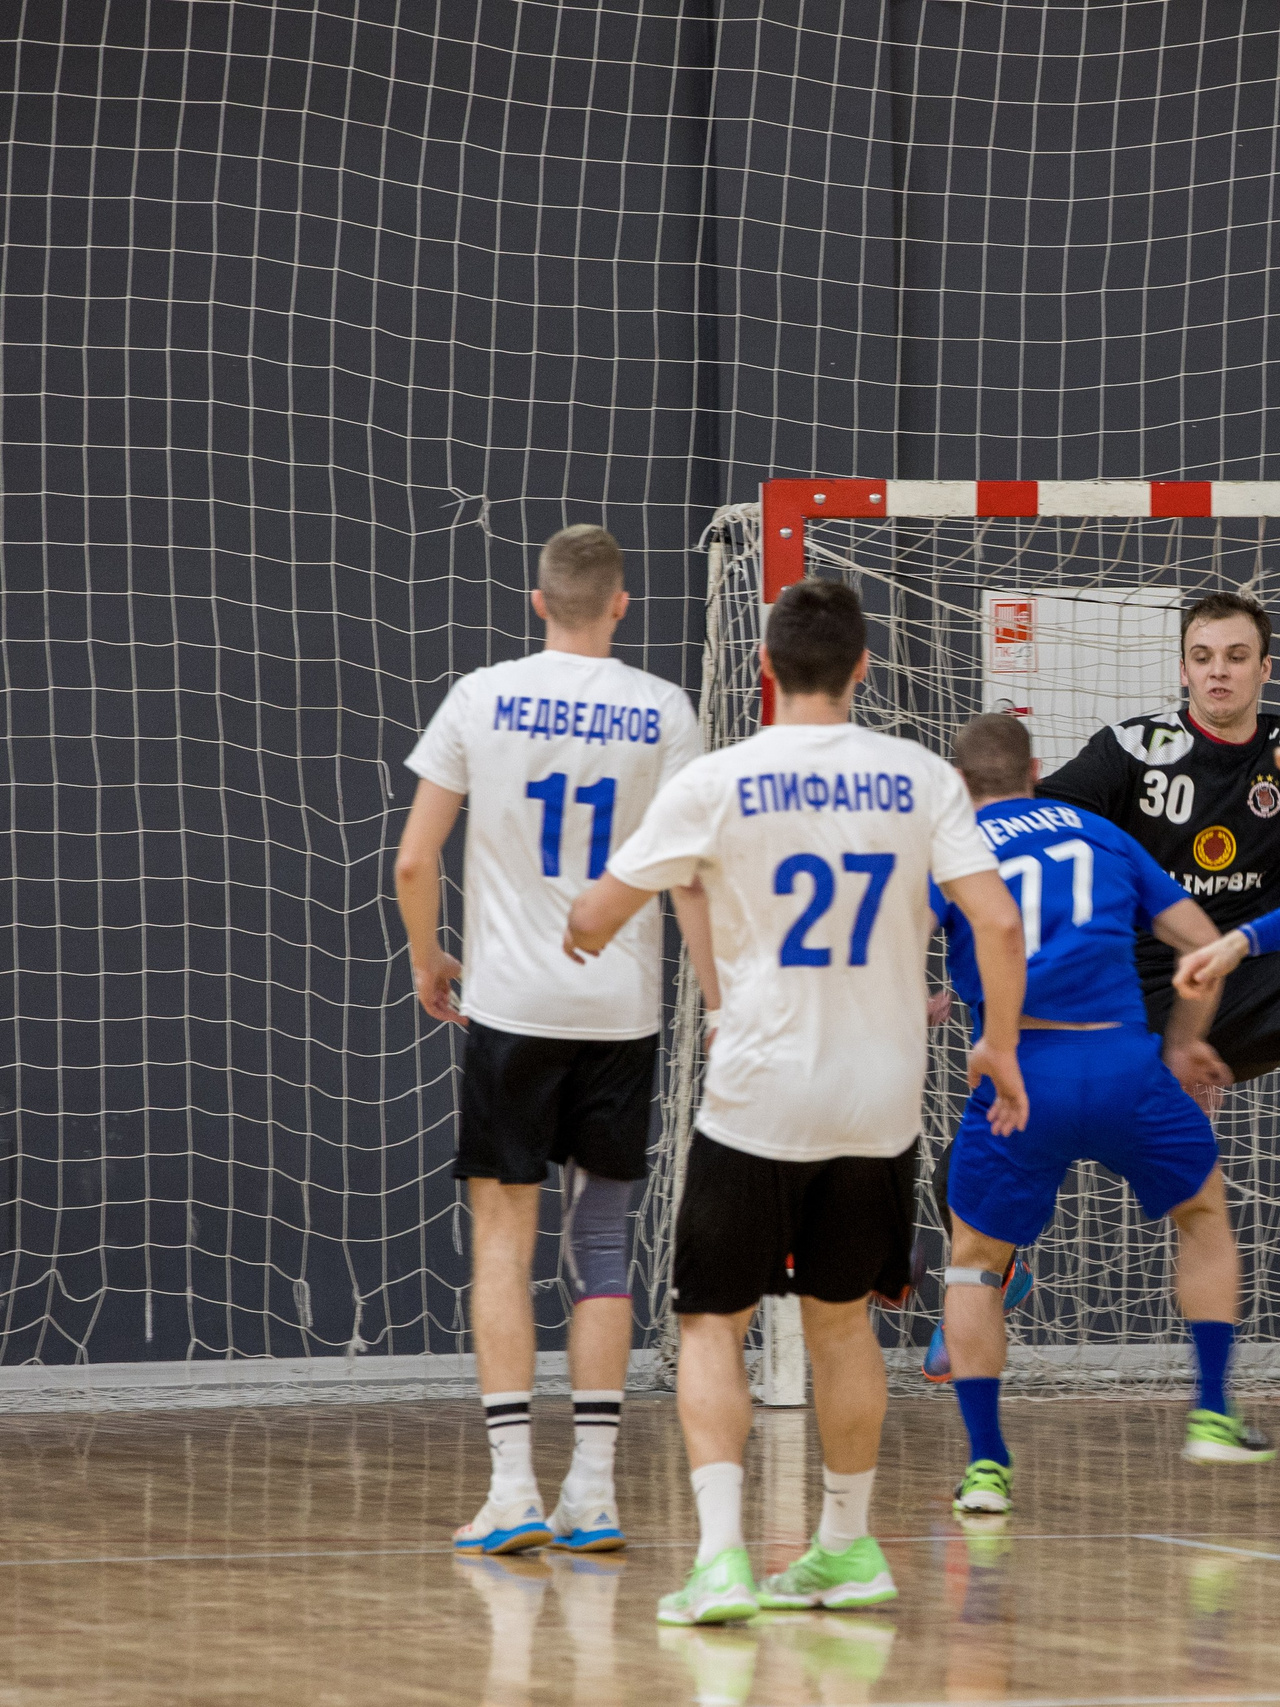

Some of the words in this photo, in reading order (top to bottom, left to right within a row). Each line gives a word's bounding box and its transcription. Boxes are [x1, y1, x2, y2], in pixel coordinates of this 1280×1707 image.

[493, 695, 661, 746] МЕДВЕДКОВ
[526, 772, 617, 881] 11
[737, 771, 914, 817] ЕПИФАНОВ
[1139, 769, 1195, 825] 30
[772, 852, 897, 967] 27
[998, 838, 1095, 960] 77
